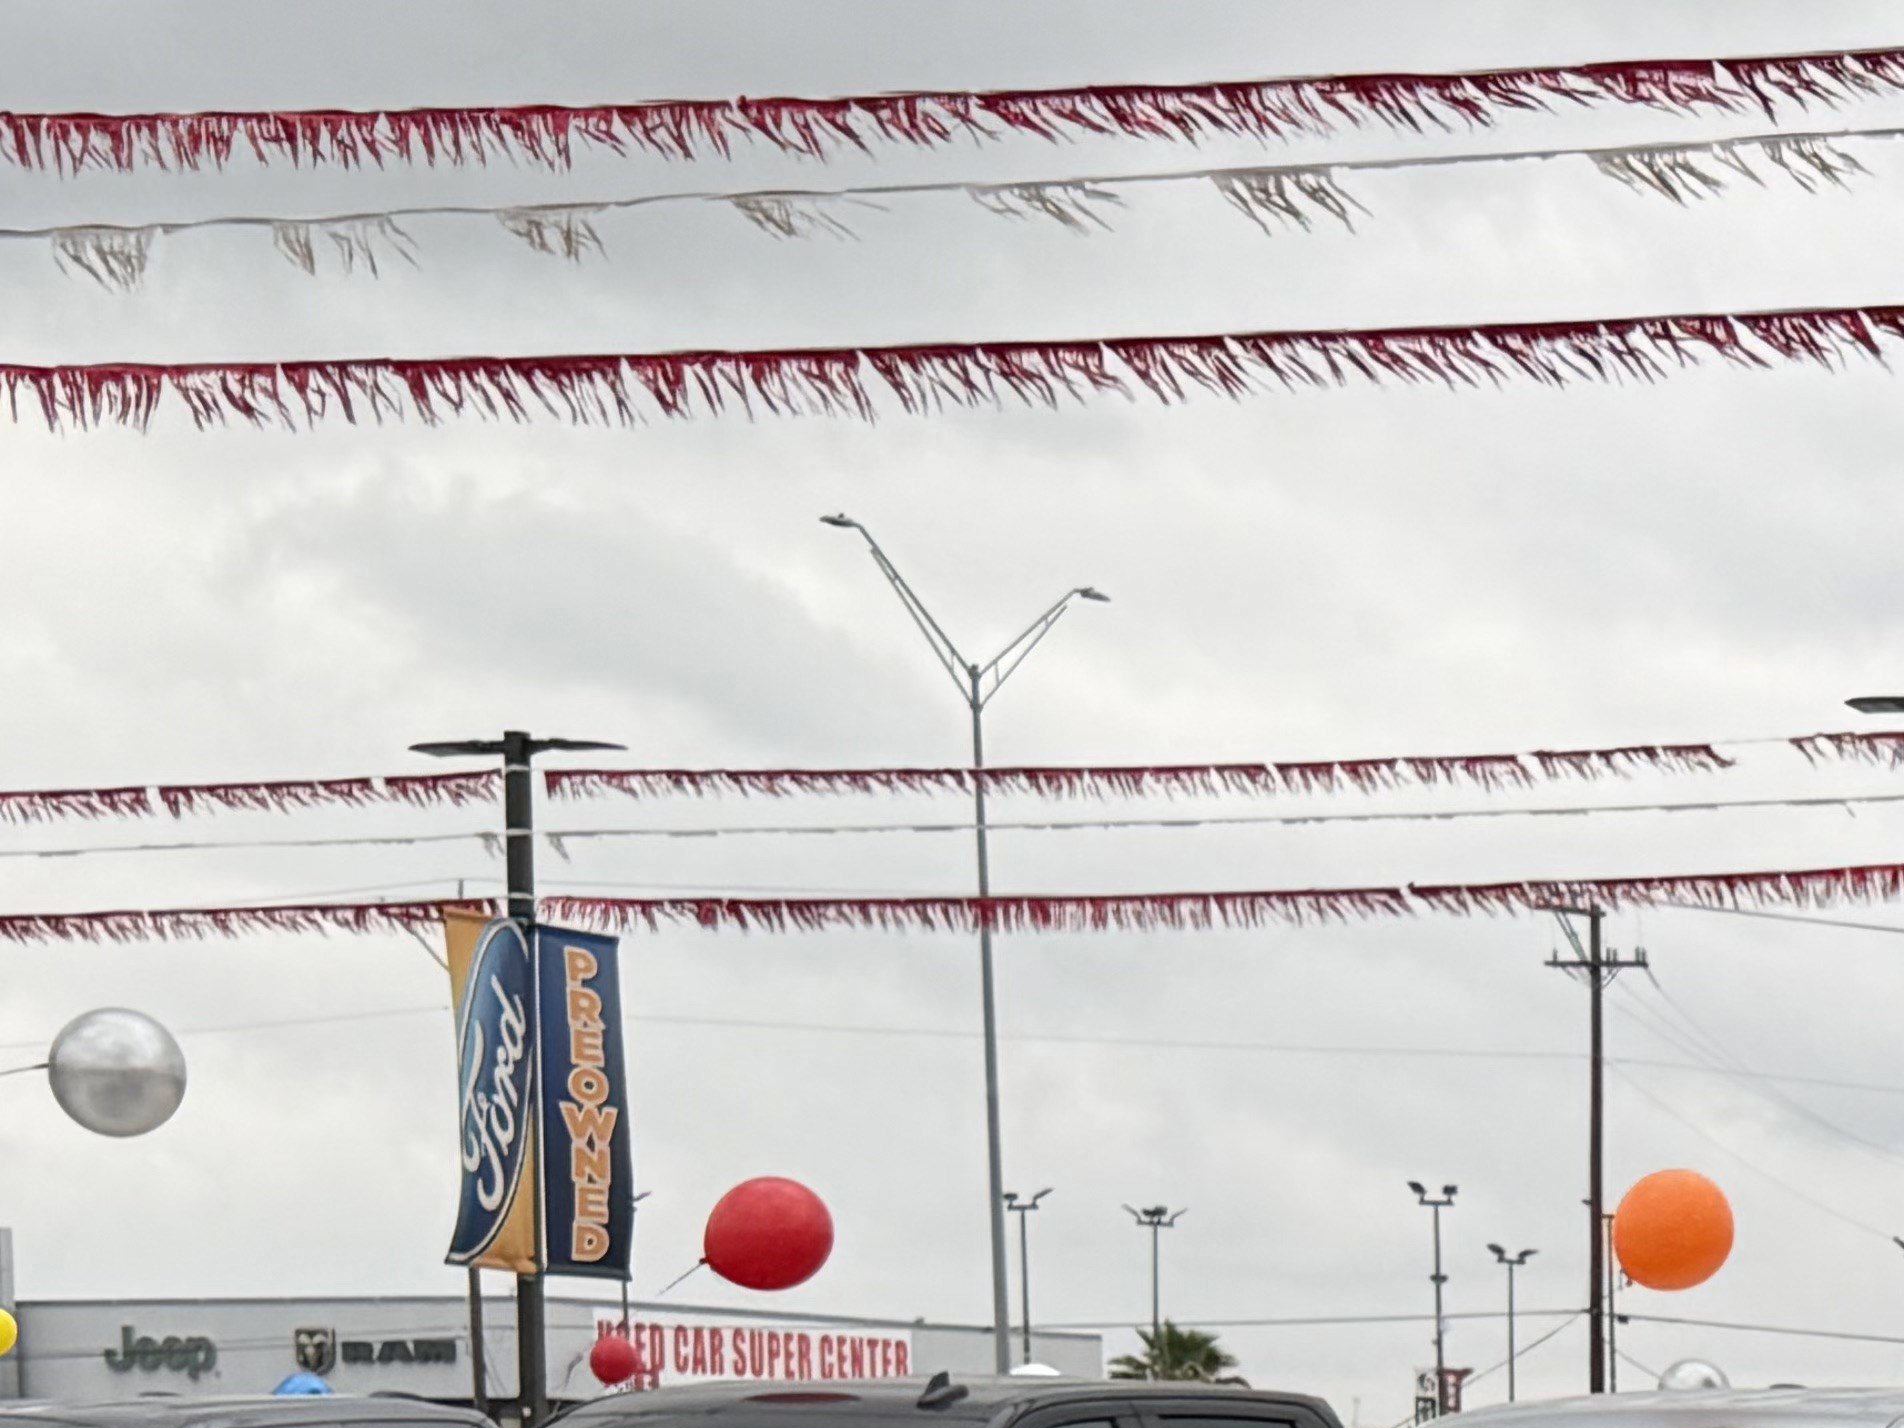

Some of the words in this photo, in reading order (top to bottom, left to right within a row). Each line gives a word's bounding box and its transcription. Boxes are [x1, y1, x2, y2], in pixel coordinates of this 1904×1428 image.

[462, 974, 527, 1212] Ford
[559, 945, 618, 1262] PREOWNED
[673, 1324, 725, 1376] CAR
[732, 1327, 813, 1381] SUPER
[819, 1333, 909, 1379] CENTER
